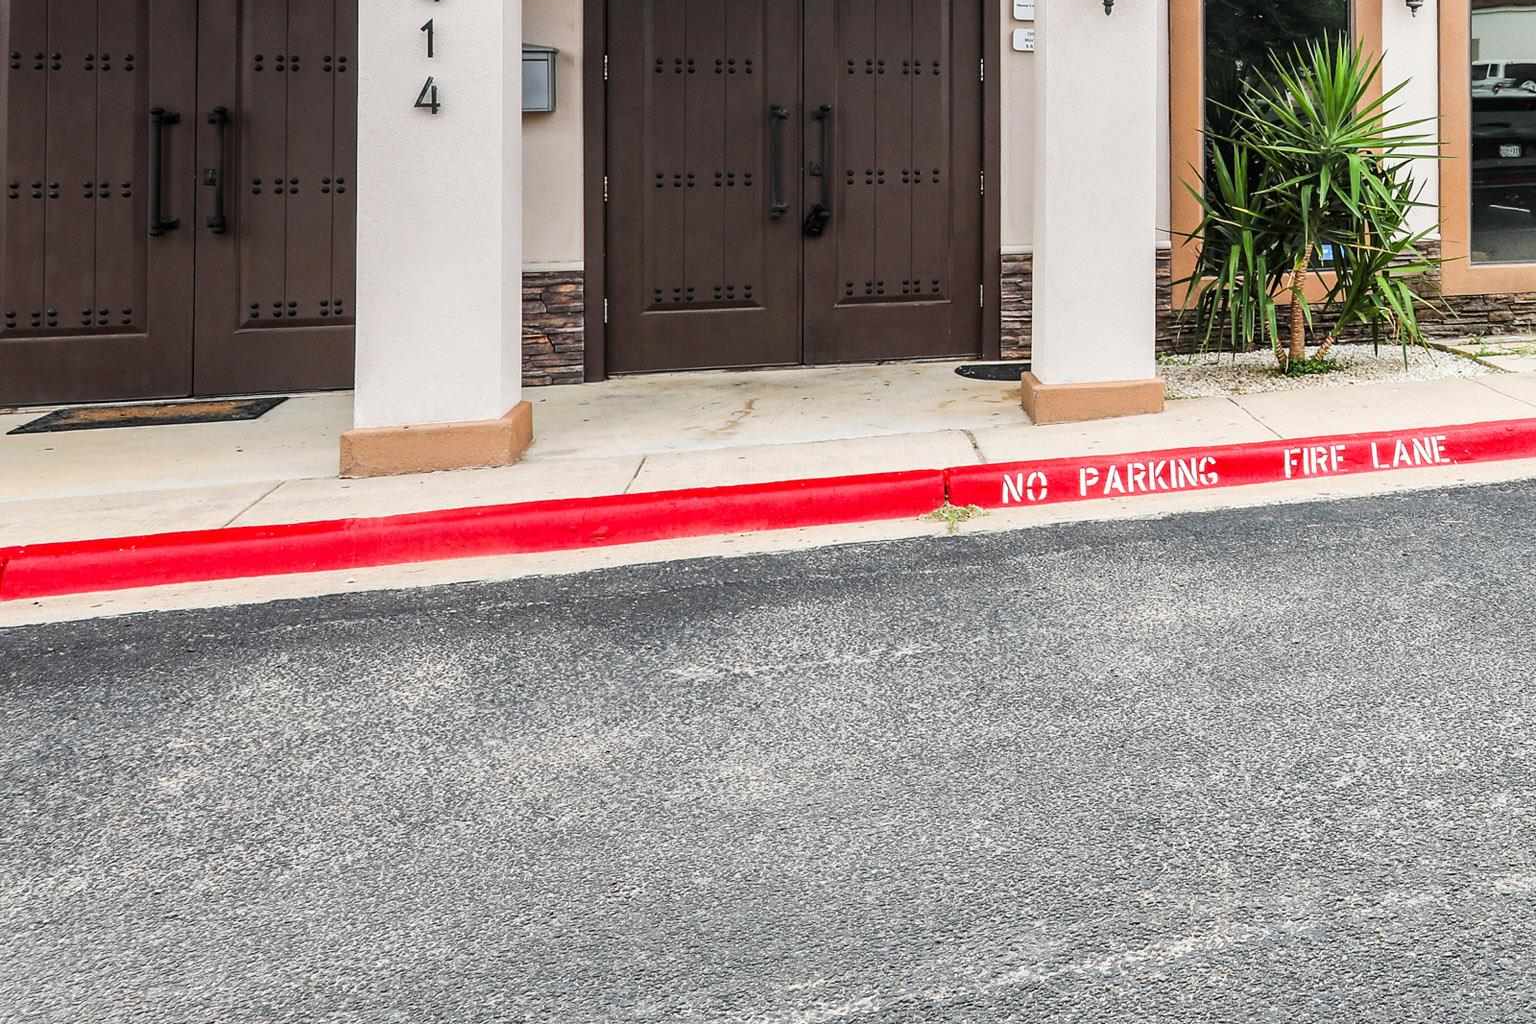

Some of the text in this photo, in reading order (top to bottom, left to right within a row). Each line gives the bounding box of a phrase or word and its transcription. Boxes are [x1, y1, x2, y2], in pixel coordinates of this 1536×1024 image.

[1001, 434, 1451, 505] NO PARKING FIRE LANE
